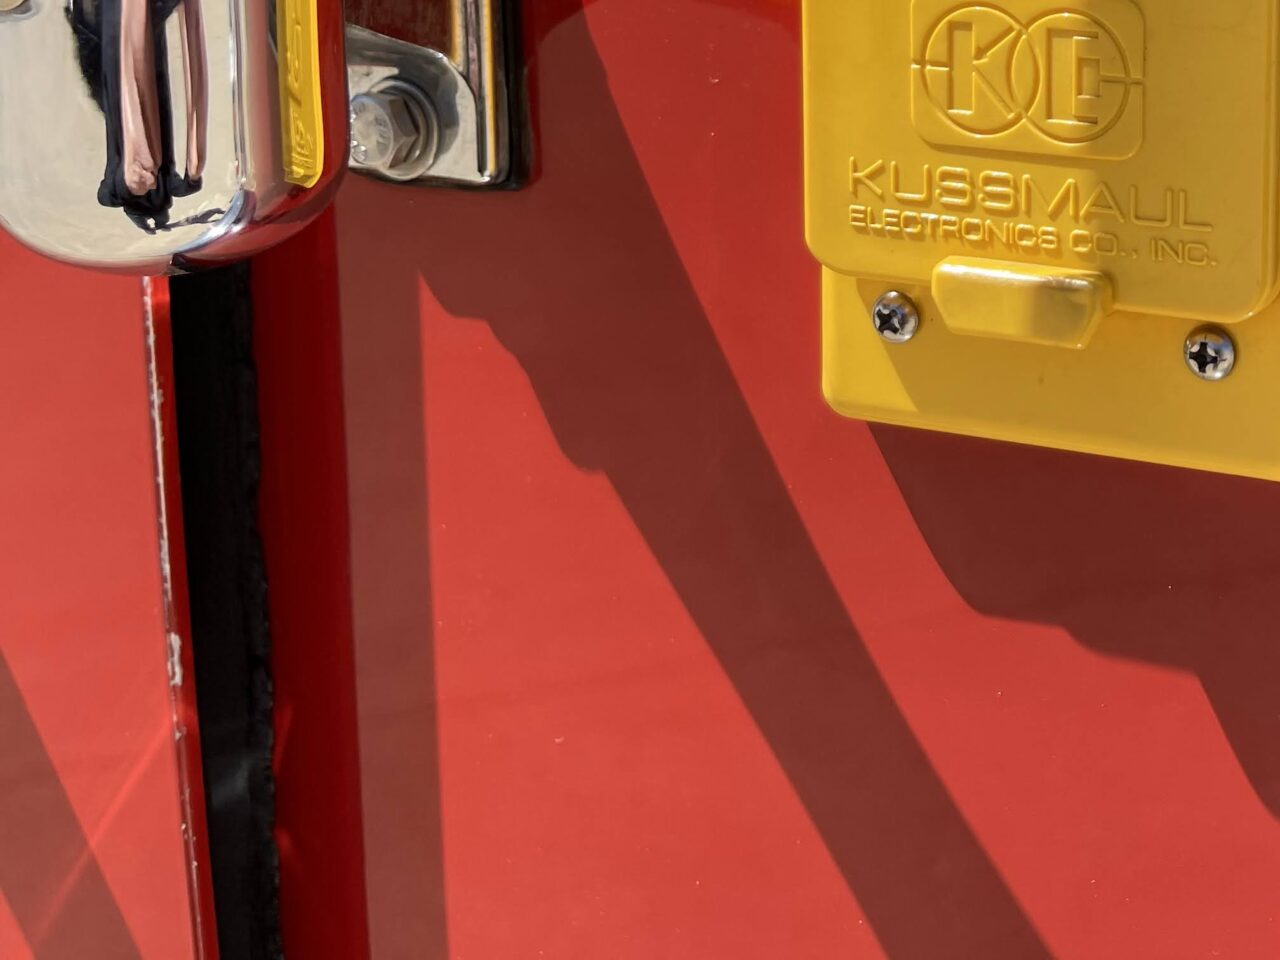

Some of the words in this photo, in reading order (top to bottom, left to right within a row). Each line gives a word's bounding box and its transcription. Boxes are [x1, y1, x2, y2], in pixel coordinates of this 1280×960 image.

[849, 156, 1213, 233] KUSSMAUL
[849, 204, 1059, 251] ELECTRONICS
[1151, 238, 1217, 266] INC.
